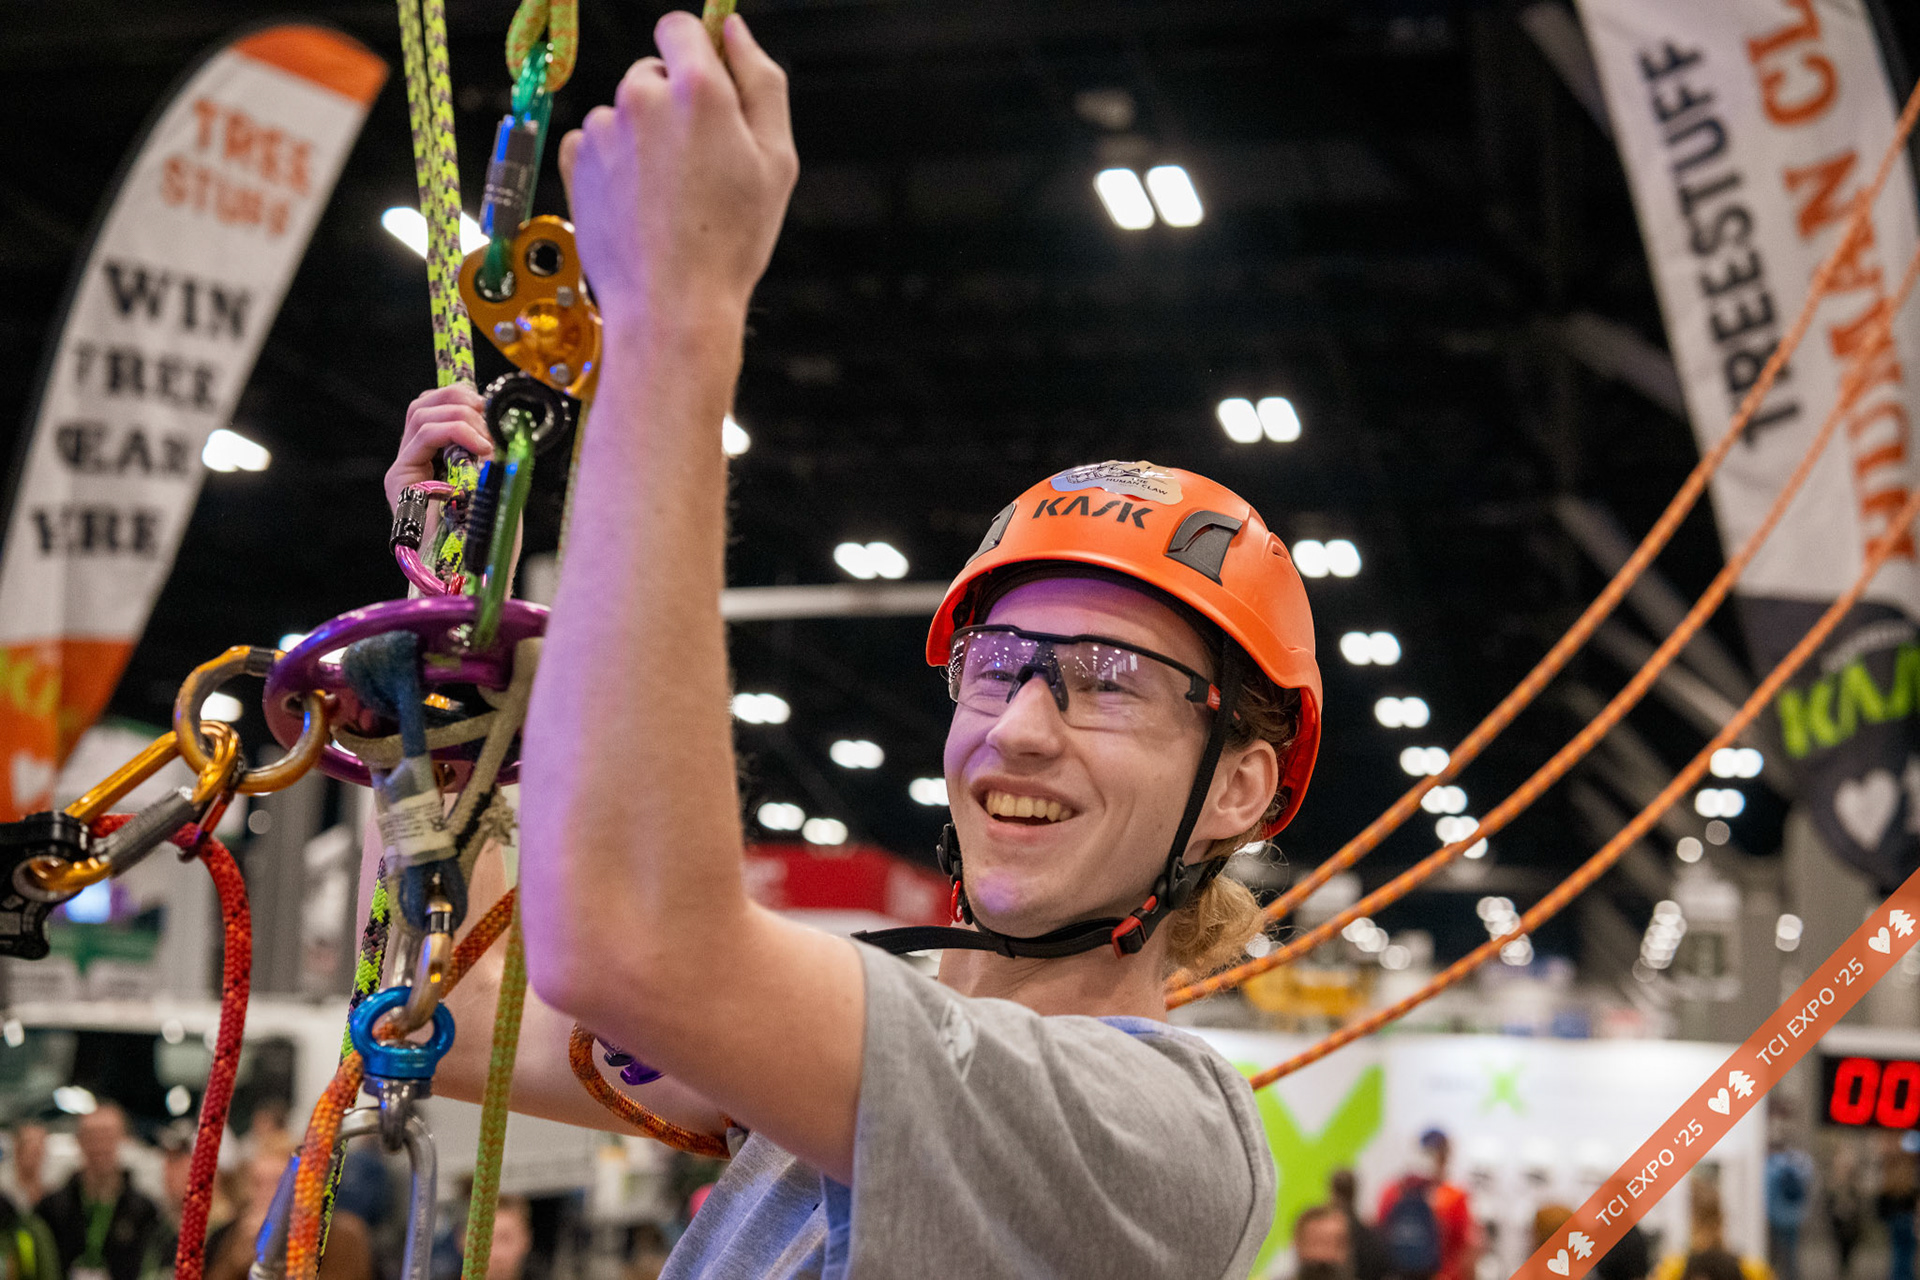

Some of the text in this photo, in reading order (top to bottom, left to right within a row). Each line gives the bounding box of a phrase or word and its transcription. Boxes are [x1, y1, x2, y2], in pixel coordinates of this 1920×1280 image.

[193, 98, 314, 198] TREE
[1639, 38, 1803, 449] TREESTUFF
[104, 258, 252, 340] WIN
[1033, 495, 1153, 529] KASK
[1105, 477, 1139, 486] HUMAN
[1141, 484, 1168, 495] CLAW
[1829, 1056, 1920, 1129] 00
